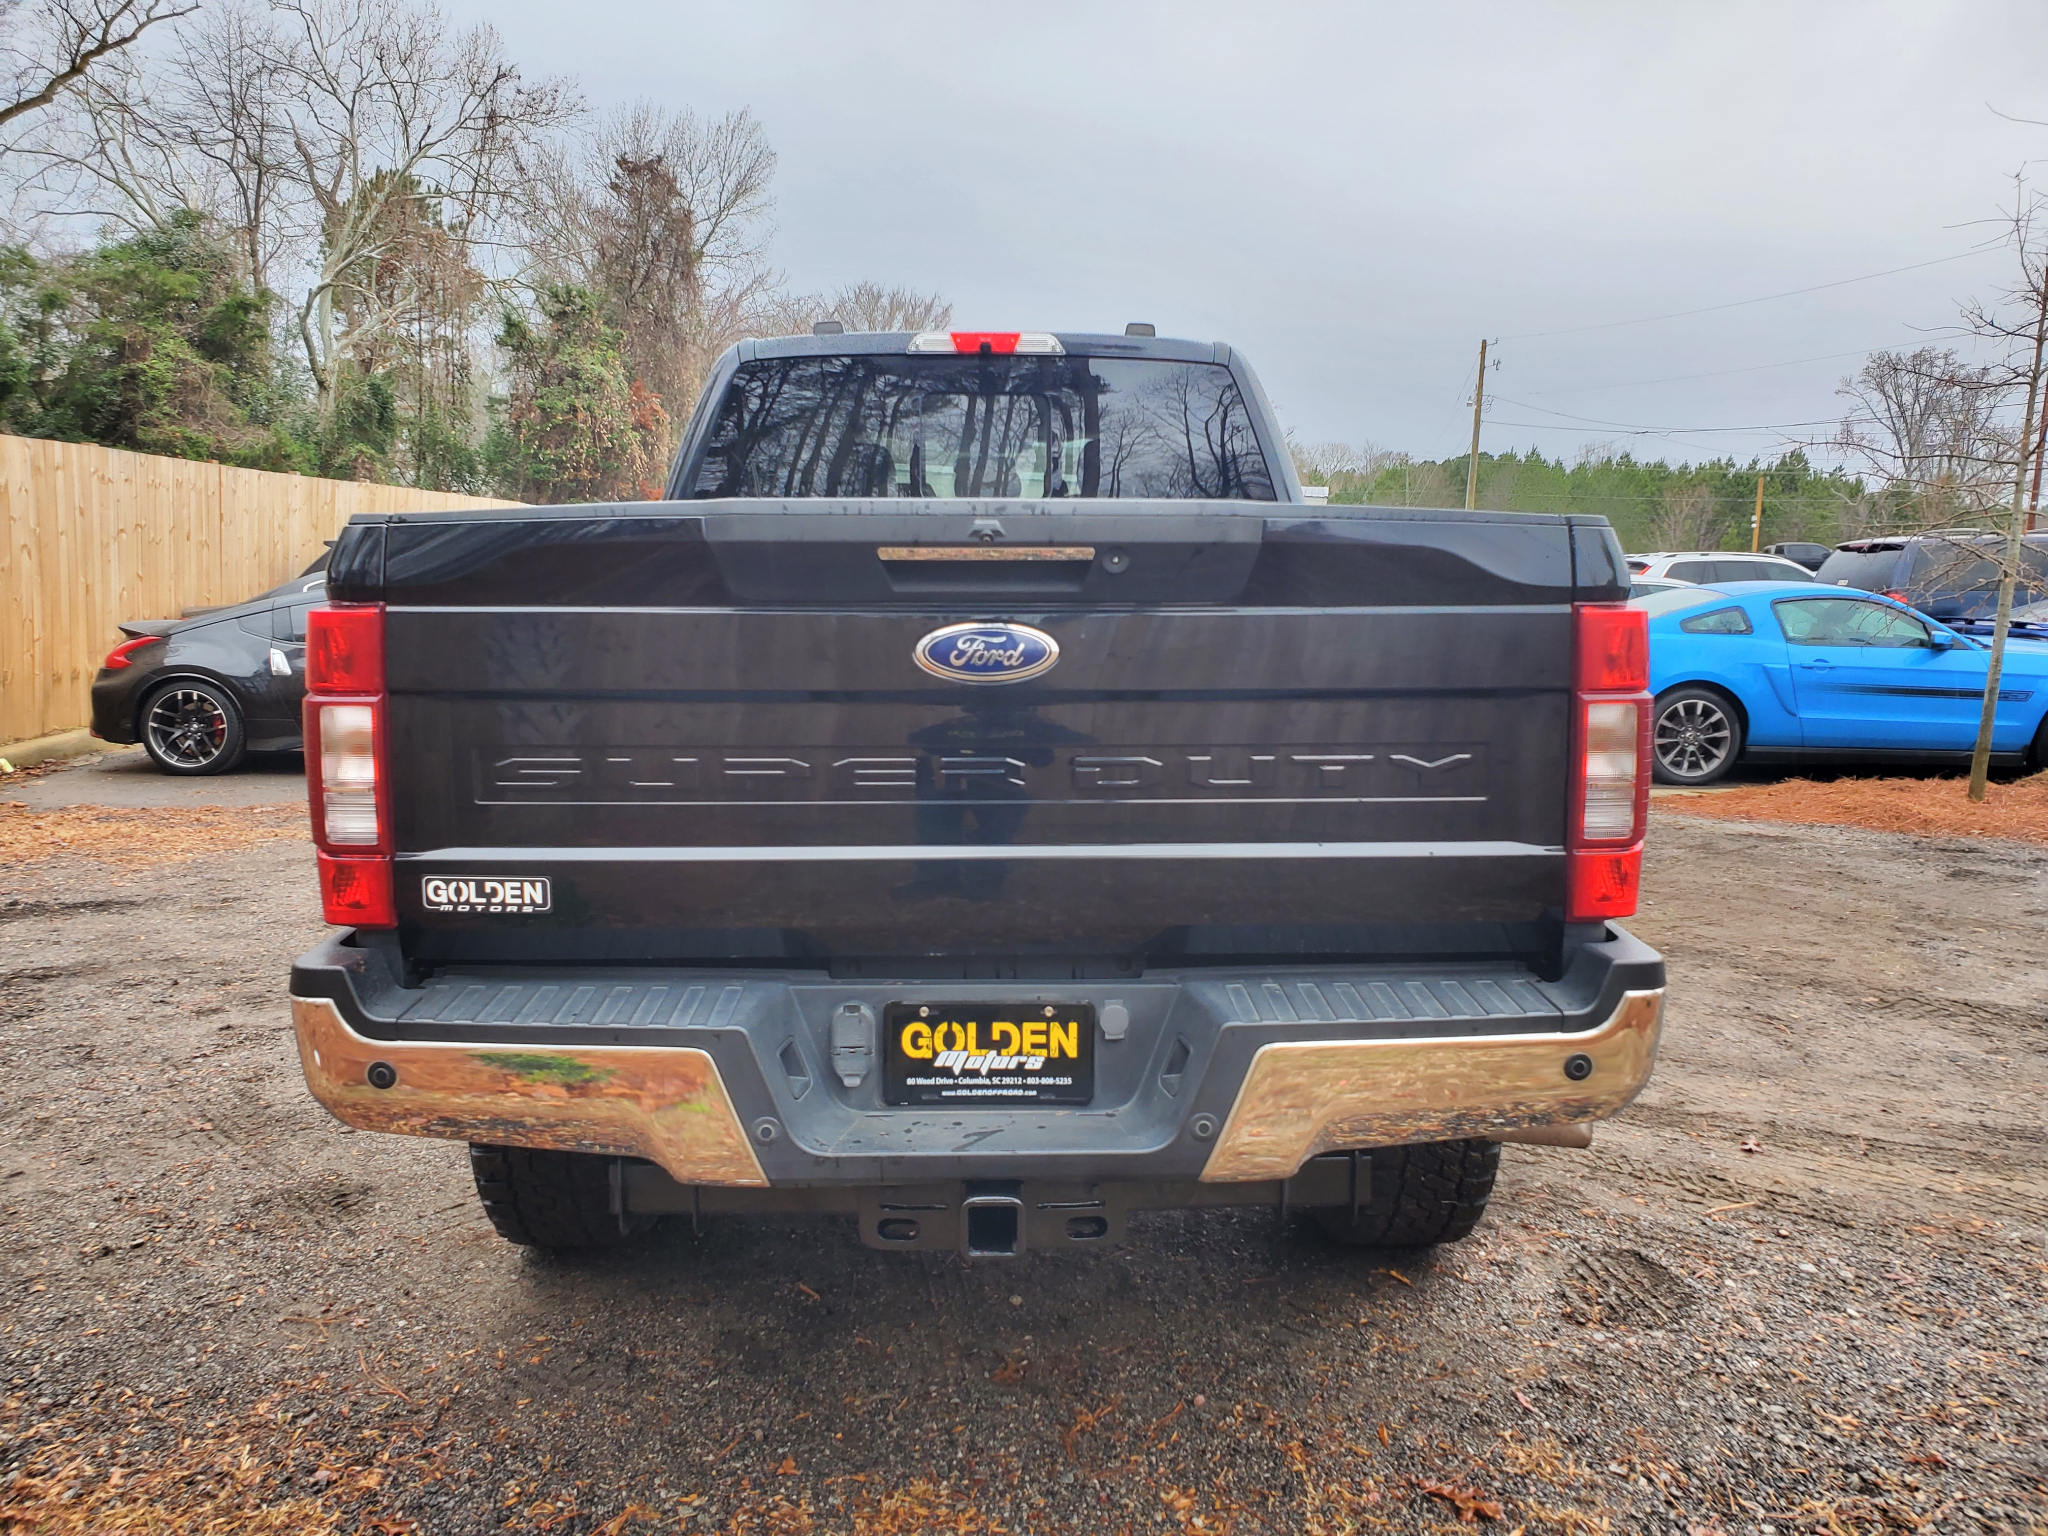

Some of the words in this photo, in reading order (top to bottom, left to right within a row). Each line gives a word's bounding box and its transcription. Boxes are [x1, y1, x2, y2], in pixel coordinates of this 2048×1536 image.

[950, 634, 1025, 666] Ford
[495, 756, 1026, 789] SUPER
[1072, 753, 1472, 788] DUTY
[426, 880, 543, 904] GOLDEN
[439, 904, 535, 912] MOTORS
[901, 1021, 1078, 1059] GOLDEN
[933, 1050, 1046, 1076] Motors
[916, 1077, 935, 1085] Weed
[936, 1077, 954, 1085] Drive
[958, 1076, 991, 1085] Columbia,
[992, 1076, 1002, 1085] SC
[1002, 1076, 1022, 1085] 29212
